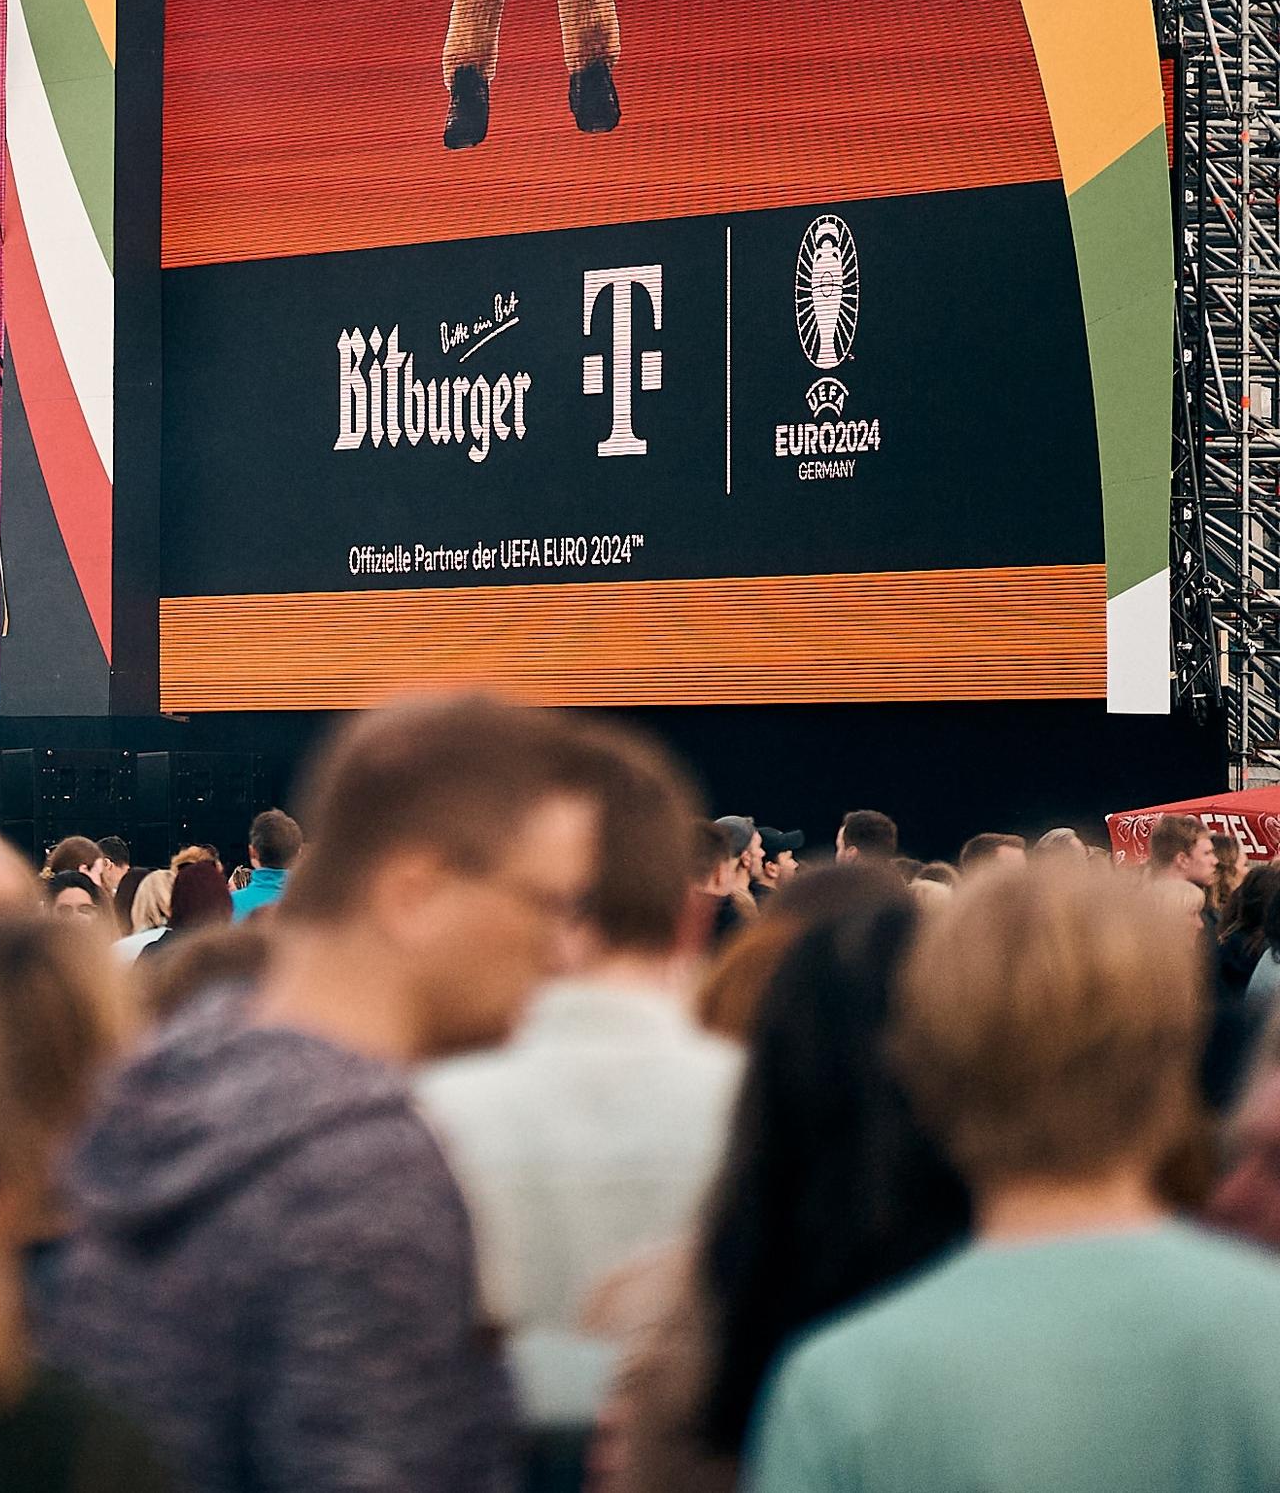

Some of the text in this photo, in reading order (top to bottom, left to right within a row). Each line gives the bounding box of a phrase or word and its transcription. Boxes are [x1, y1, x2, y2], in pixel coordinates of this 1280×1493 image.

[440, 321, 470, 354] Bitte
[494, 291, 519, 322] Bit
[583, 264, 663, 457] T
[333, 324, 532, 463] Bitburger
[807, 384, 845, 412] UEFA
[798, 459, 856, 480] GERMANY
[348, 545, 411, 575] Offizielle
[414, 543, 469, 572] Partner
[472, 542, 498, 570] der
[500, 538, 541, 569] UEFA
[544, 536, 588, 567] EURO
[1184, 813, 1268, 854] EZEL
